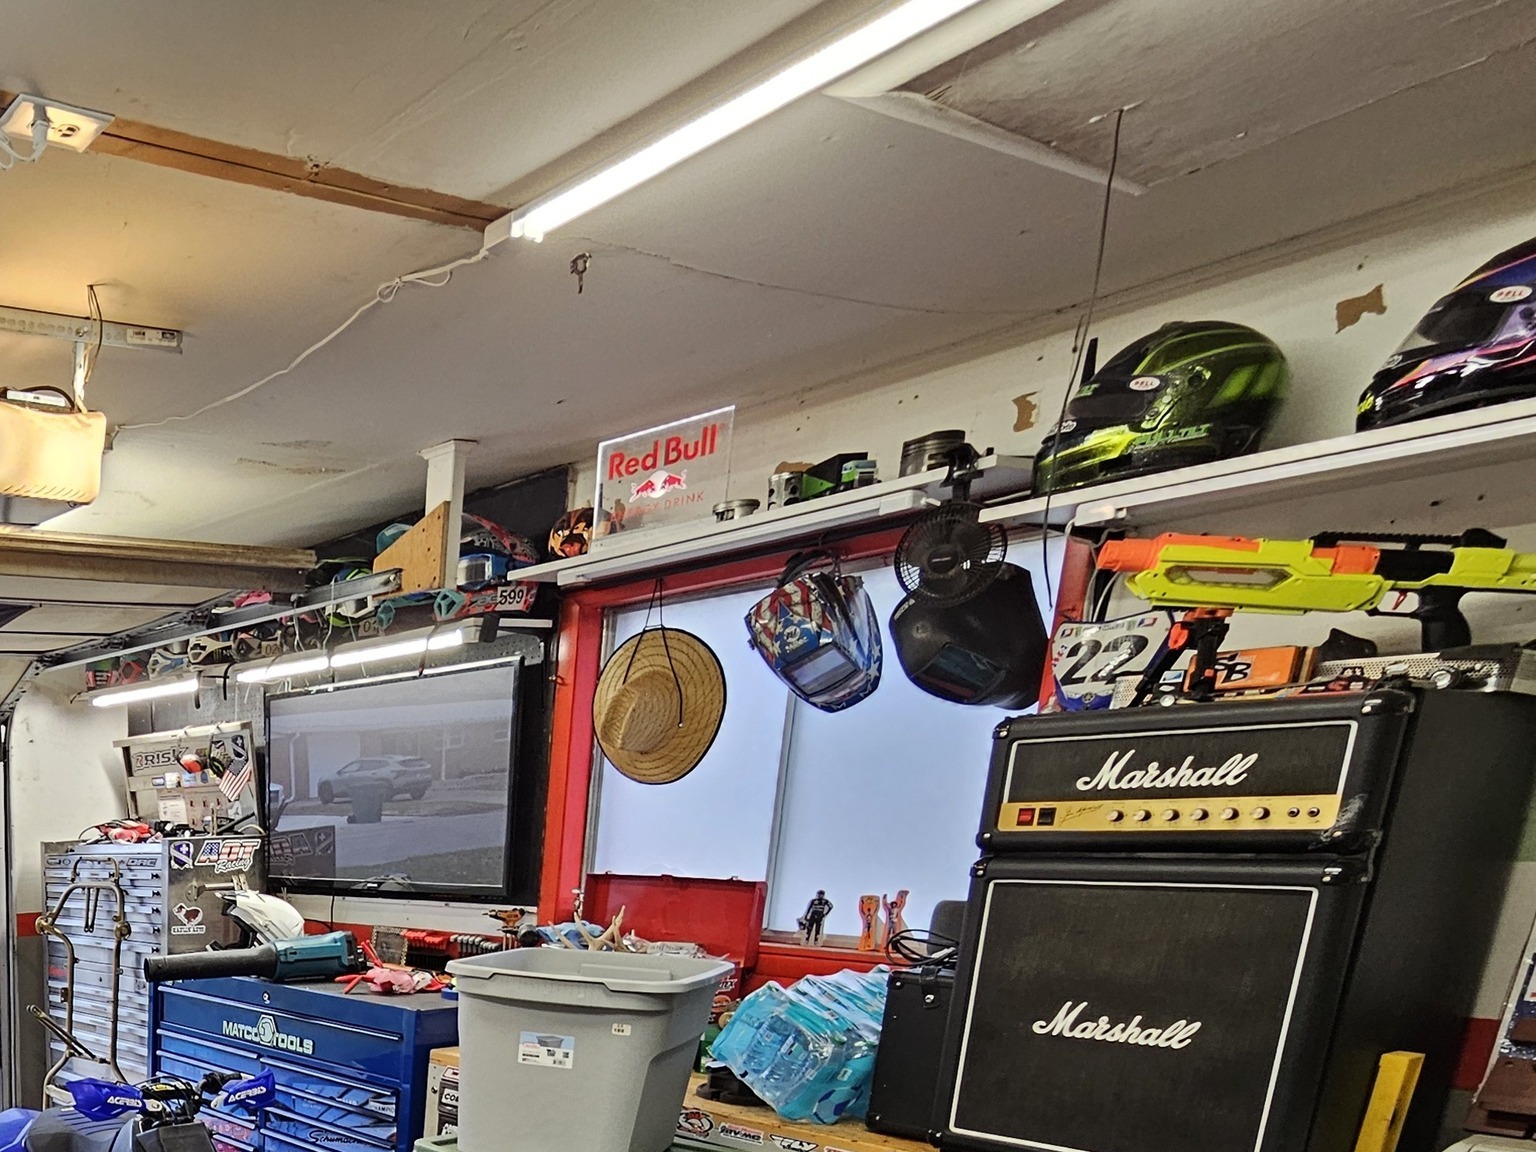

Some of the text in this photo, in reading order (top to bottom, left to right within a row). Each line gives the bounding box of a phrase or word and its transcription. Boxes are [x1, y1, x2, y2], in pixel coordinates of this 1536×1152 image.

[608, 424, 717, 480] Red Bull
[664, 492, 704, 509] DRINK
[498, 588, 525, 605] 599
[1060, 634, 1150, 685] 22
[1076, 749, 1258, 791] Marshall
[215, 857, 252, 874] Racing
[222, 1020, 314, 1054] MATCO TOOLS
[1032, 1001, 1202, 1049] Marshall
[107, 1096, 142, 1107] ACERBIS
[228, 1086, 267, 1103] ACERBIS
